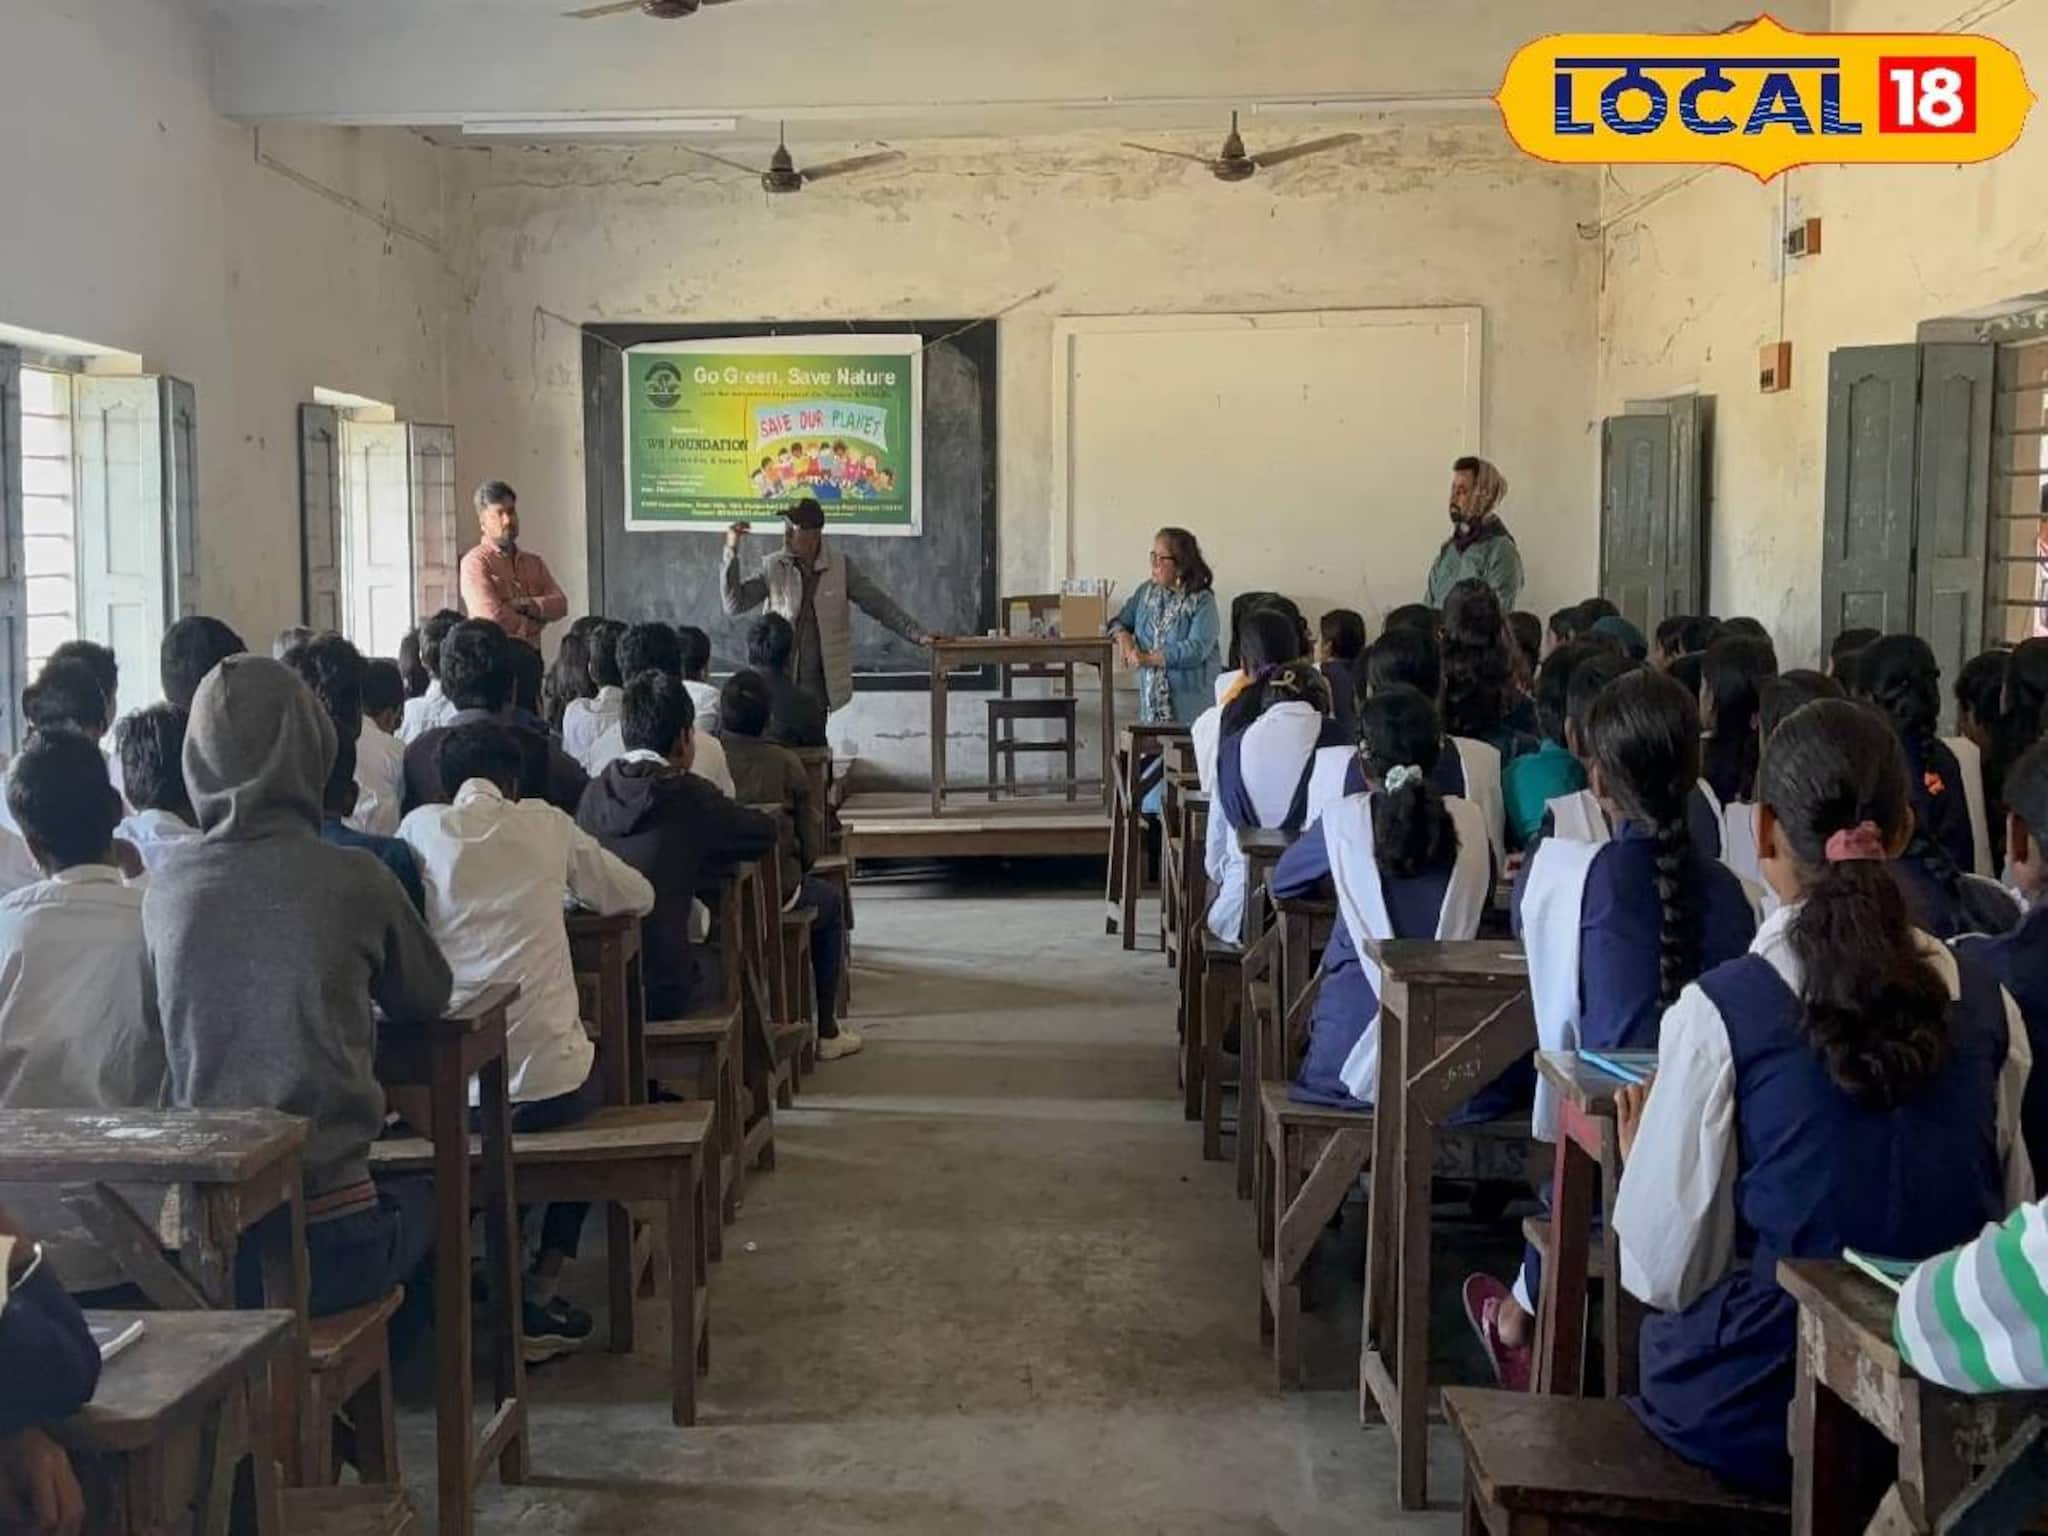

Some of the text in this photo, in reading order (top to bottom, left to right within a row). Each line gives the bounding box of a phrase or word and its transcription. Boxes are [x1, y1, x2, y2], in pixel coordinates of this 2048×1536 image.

[694, 366, 719, 385] Go
[788, 367, 831, 385] Save
[837, 367, 896, 385] Nature
[760, 409, 880, 438] SAVE OUR PLANET
[669, 438, 748, 451] FOUNDATION
